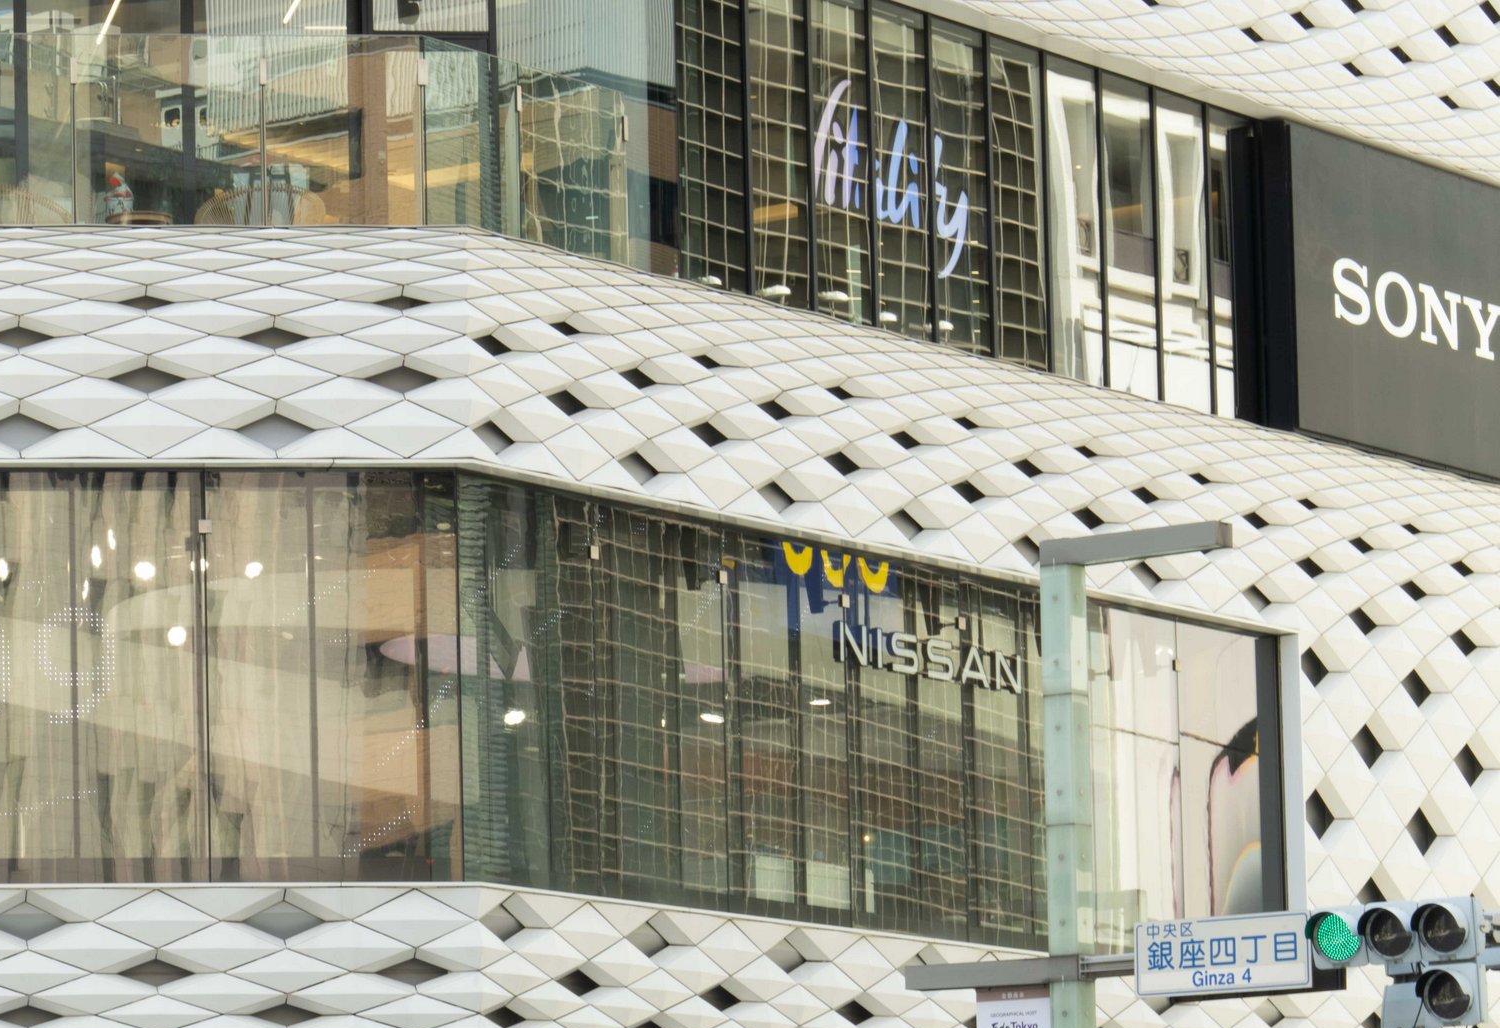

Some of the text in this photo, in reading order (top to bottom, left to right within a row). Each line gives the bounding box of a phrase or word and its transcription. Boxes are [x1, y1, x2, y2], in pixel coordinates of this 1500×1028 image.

[1333, 258, 1500, 361] SONY
[838, 621, 1022, 695] NISSAN
[1146, 921, 1194, 940] 中央区
[1147, 931, 1298, 972] 銀座四丁目
[1192, 967, 1252, 987] Ginza 4
